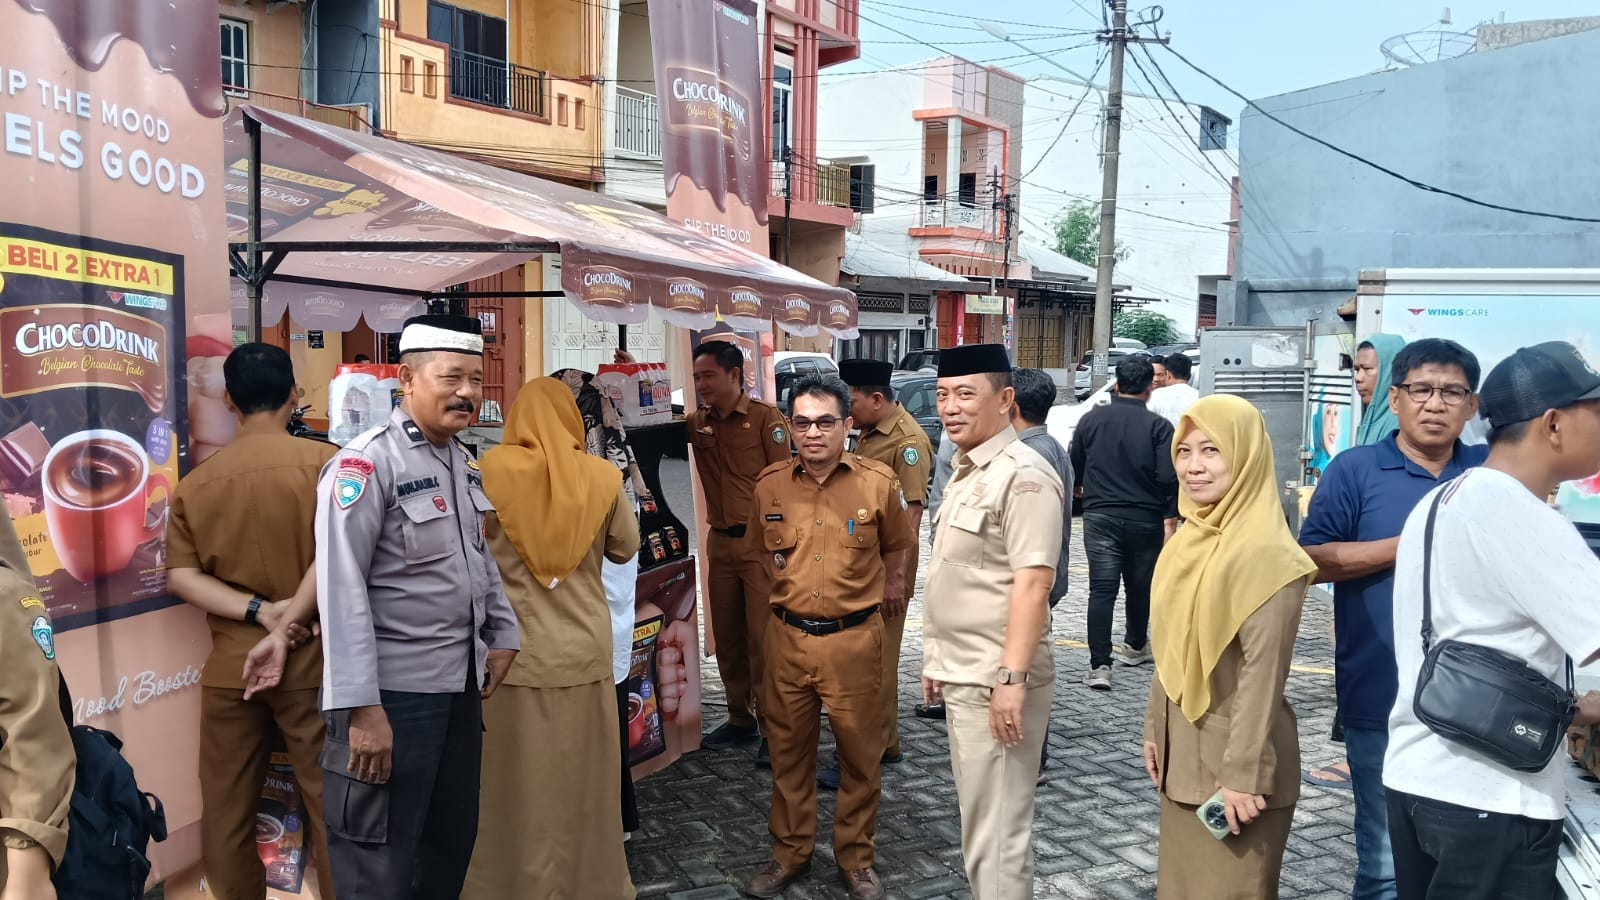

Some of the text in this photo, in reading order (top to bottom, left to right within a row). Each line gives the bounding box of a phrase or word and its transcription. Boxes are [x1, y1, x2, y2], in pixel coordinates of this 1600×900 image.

[38, 79, 91, 118] THE
[102, 99, 170, 143] MOOD
[673, 78, 746, 127] CHOCORINK
[5, 111, 205, 198] ELS GOOD
[704, 222, 725, 237] THE
[728, 229, 751, 243] OOD
[8, 244, 160, 286] BELI 2 EXTRA 1
[40, 355, 144, 376] Belgian Chocolate Taste
[20, 532, 48, 546] olate
